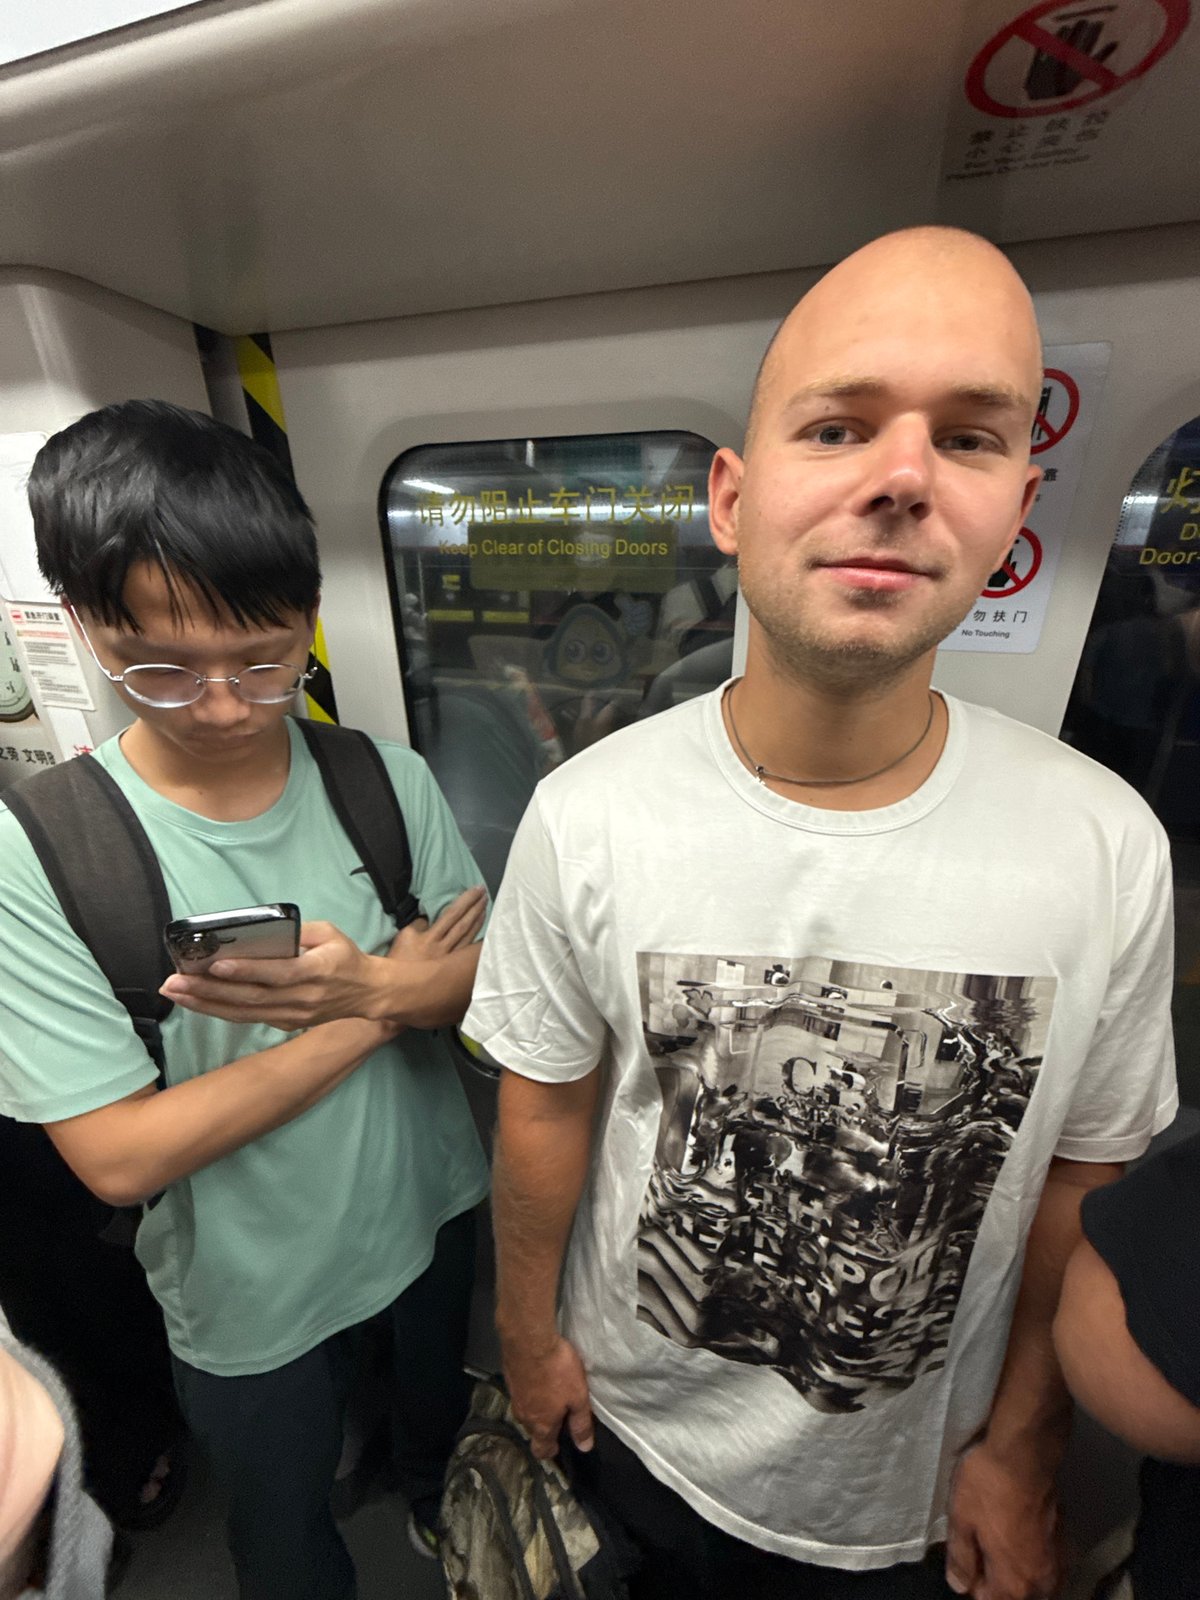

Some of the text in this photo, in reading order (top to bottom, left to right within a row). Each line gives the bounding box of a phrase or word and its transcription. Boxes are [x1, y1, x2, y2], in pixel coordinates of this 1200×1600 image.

[416, 485, 695, 527] 请勿阻止车门关闭
[439, 538, 668, 558] Keep Clear of Closing Doors
[961, 629, 1011, 639] No Touching
